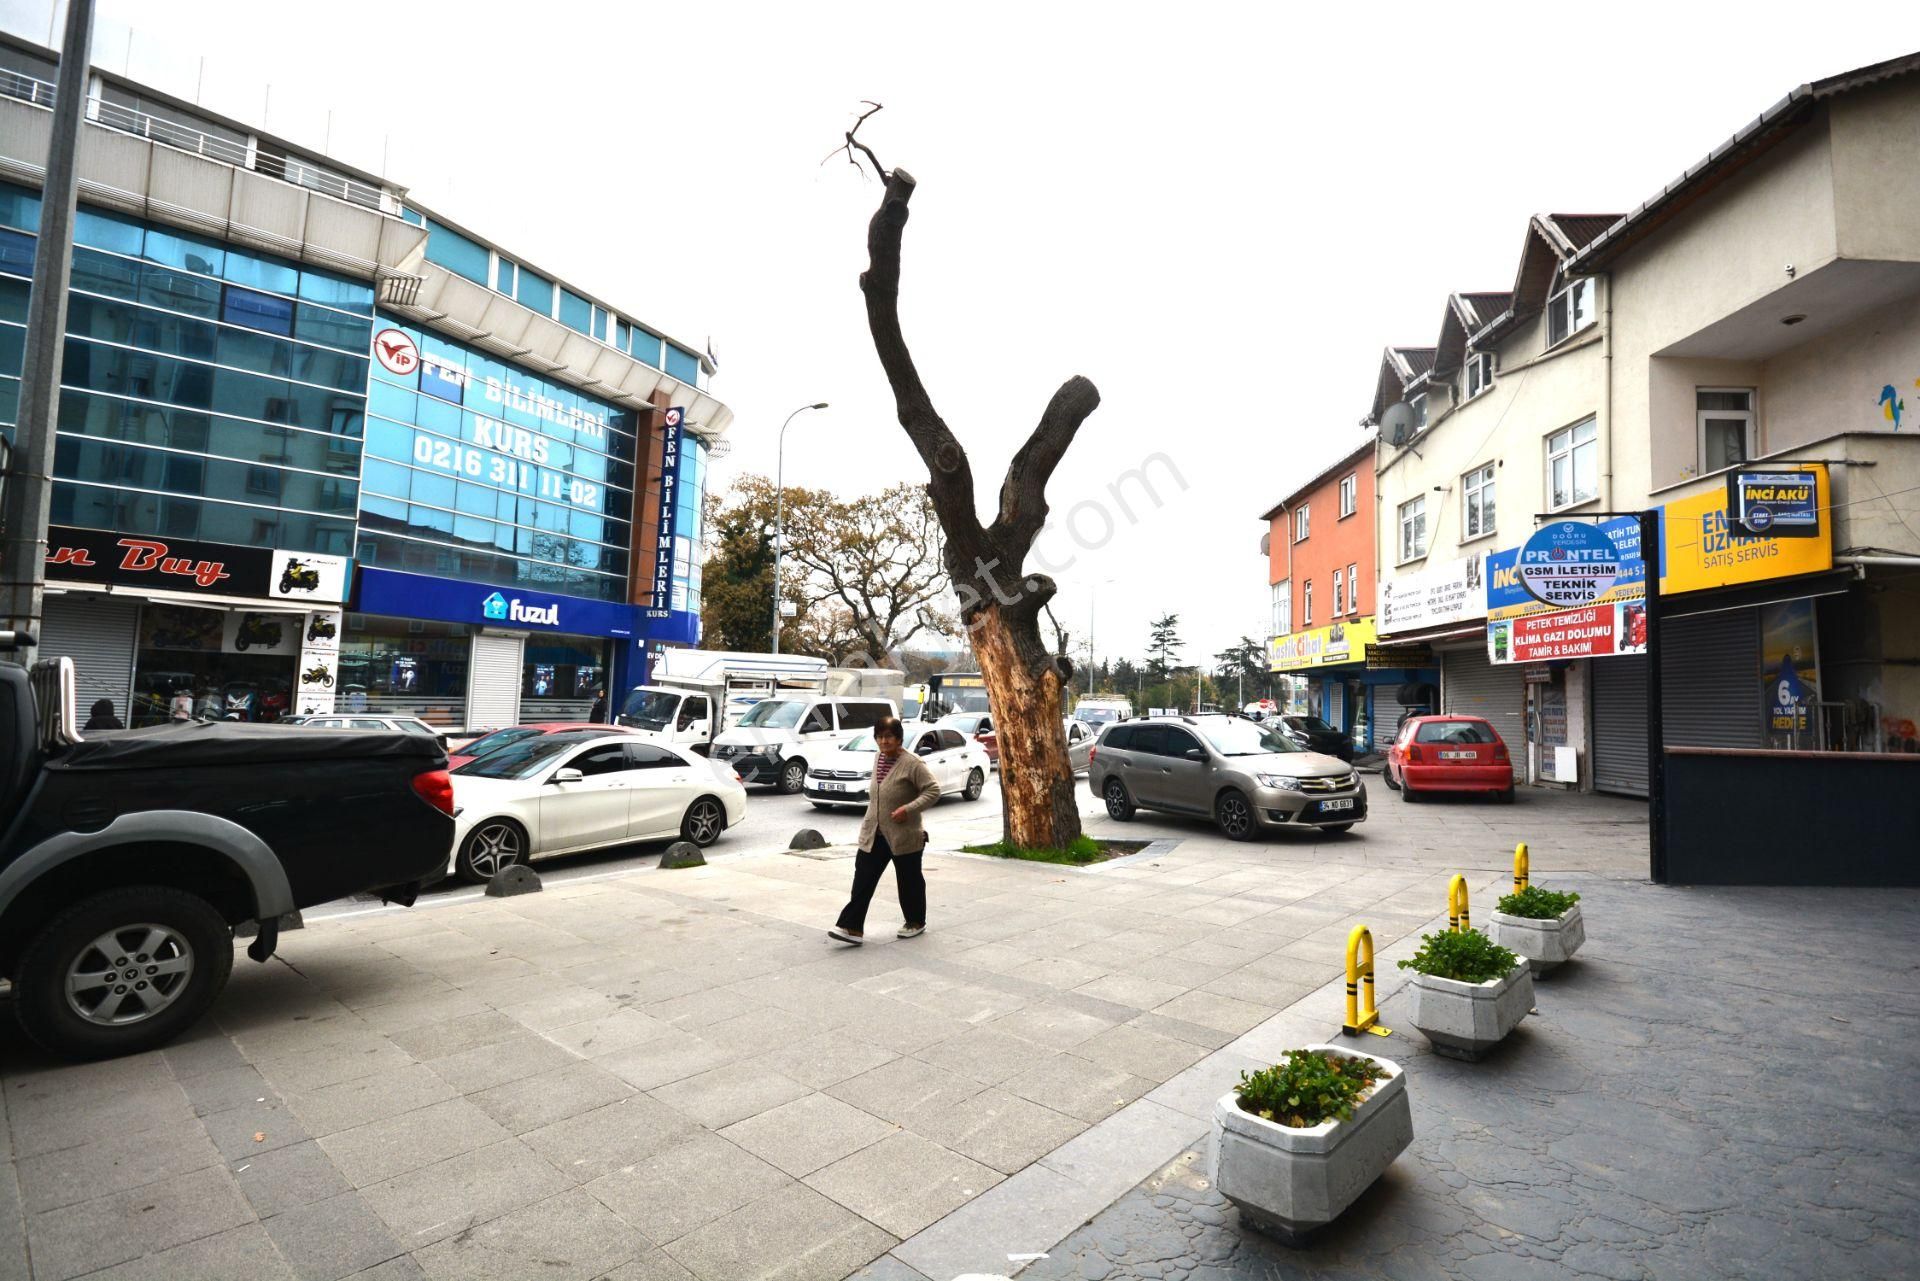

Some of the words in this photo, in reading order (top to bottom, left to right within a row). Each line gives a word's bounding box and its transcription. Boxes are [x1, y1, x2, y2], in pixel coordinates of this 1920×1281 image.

[484, 375, 606, 438] BİLİMLERİ
[472, 415, 550, 464] KURS
[664, 426, 677, 468] FEN
[414, 435, 482, 476] 0216
[489, 456, 528, 489] 311
[542, 472, 562, 499] 11
[570, 480, 597, 508] 02
[1745, 485, 1775, 500] İNCİ
[1776, 485, 1809, 500] AKÜ
[656, 474, 674, 609] BİLİMLERİ
[117, 538, 230, 586] Buy
[1704, 552, 1734, 569] SATIŞ
[1737, 542, 1779, 563] SERVİS
[1525, 566, 1553, 576] GSM
[1557, 564, 1616, 577] İLETİŞİM
[1543, 578, 1597, 589] TEKNİK
[1545, 590, 1595, 600] SERVİS
[510, 599, 560, 626] fuzul
[646, 609, 669, 618] KURS
[1526, 619, 1552, 630] PETEK
[1554, 610, 1596, 627] TEMİZLİĞİ
[1514, 632, 1541, 646] KLİMA
[1543, 630, 1565, 642] GAZI
[1567, 625, 1612, 640] DOLUMU
[1528, 645, 1552, 657] TAMİR
[1554, 645, 1560, 655] &
[1778, 680, 1790, 705] 6
